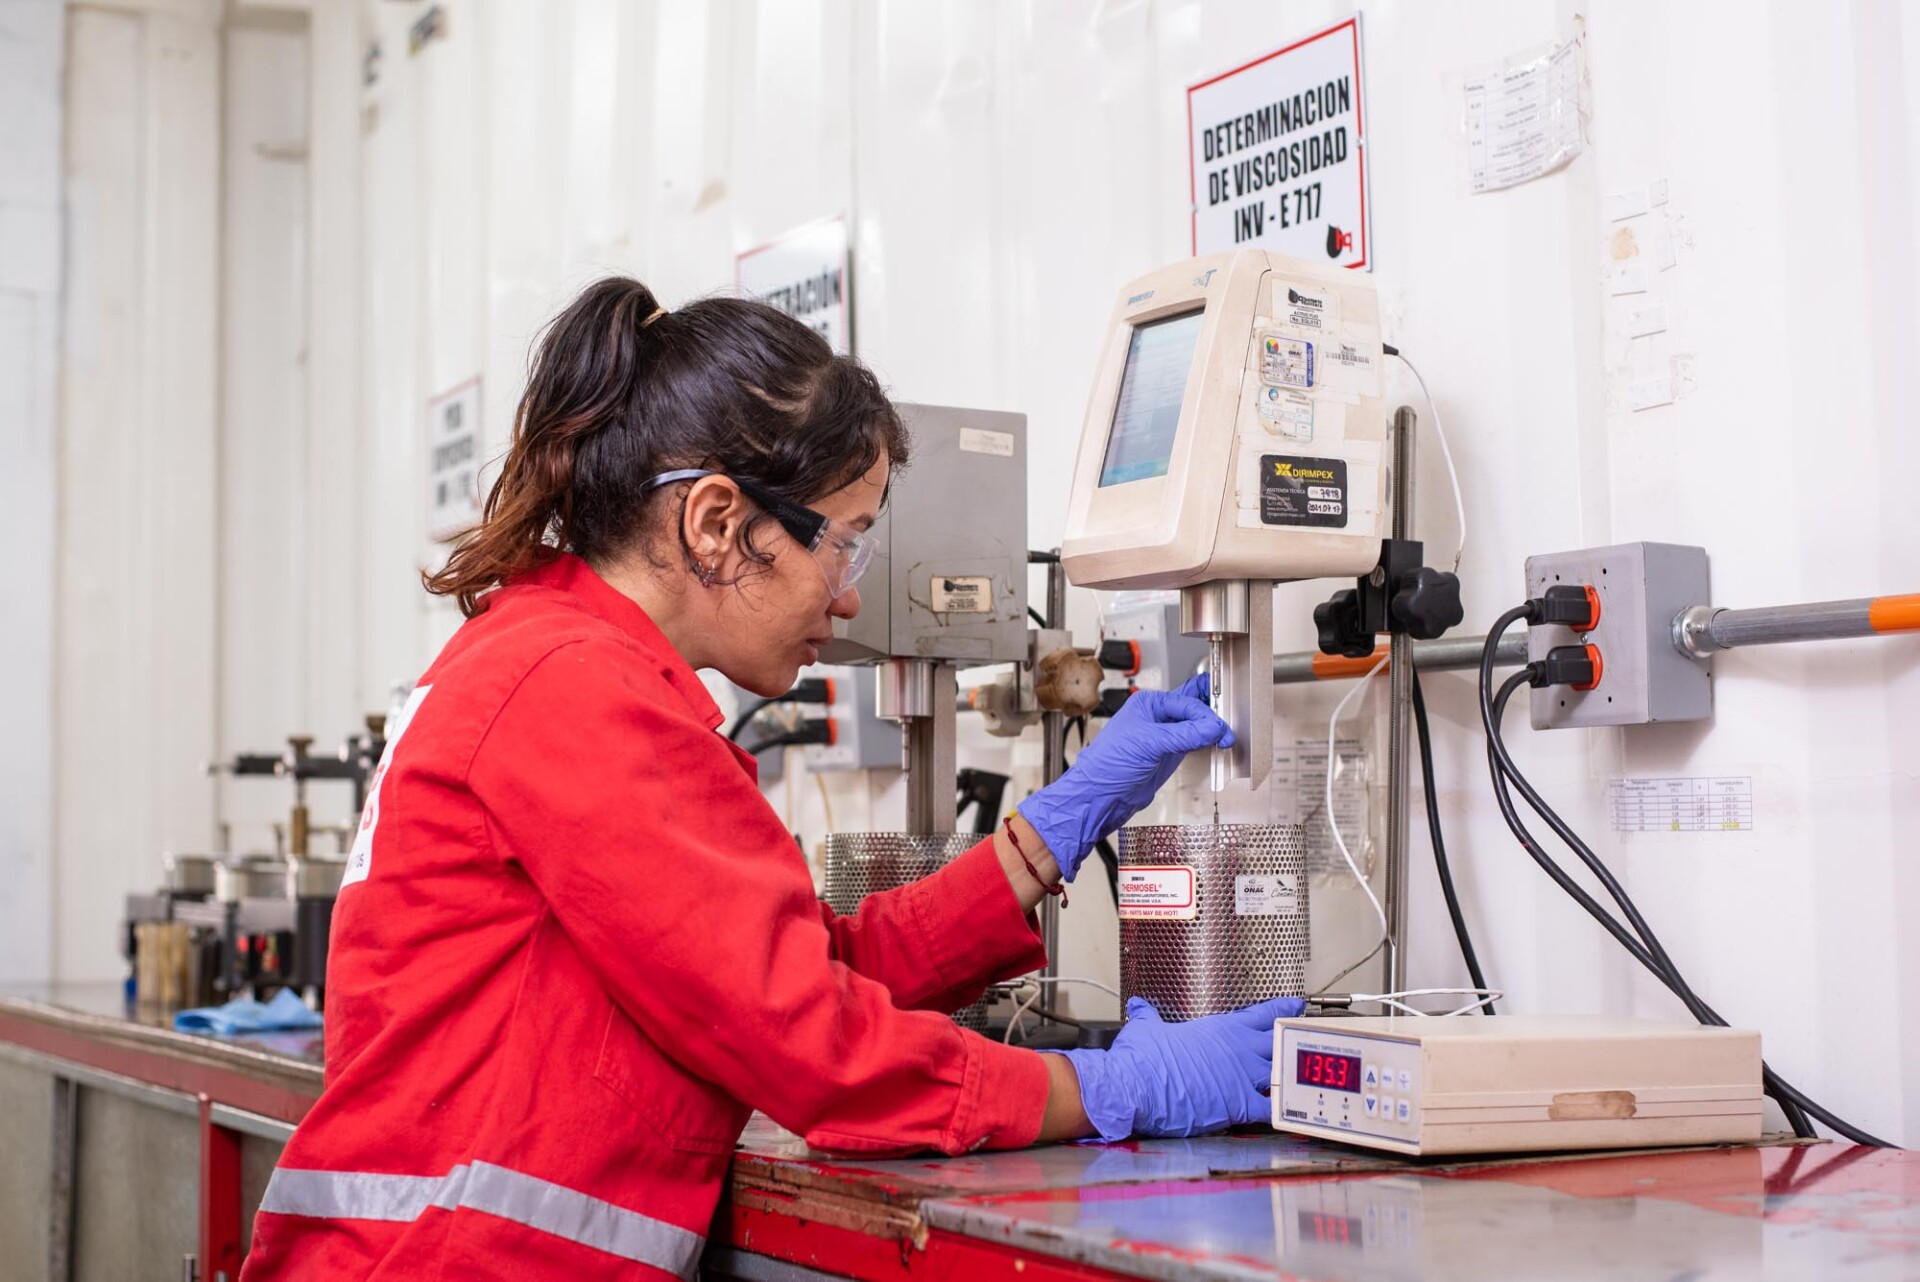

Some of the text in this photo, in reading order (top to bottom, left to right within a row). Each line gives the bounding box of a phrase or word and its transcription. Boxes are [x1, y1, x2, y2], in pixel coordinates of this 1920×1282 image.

[1203, 75, 1351, 163] DETERMINACION
[1208, 125, 1348, 206] DE VISCOSIDAD
[1234, 200, 1264, 244] INV
[1281, 192, 1289, 229] E
[1293, 182, 1322, 225] 717
[1292, 468, 1334, 479] DIRIMPEX
